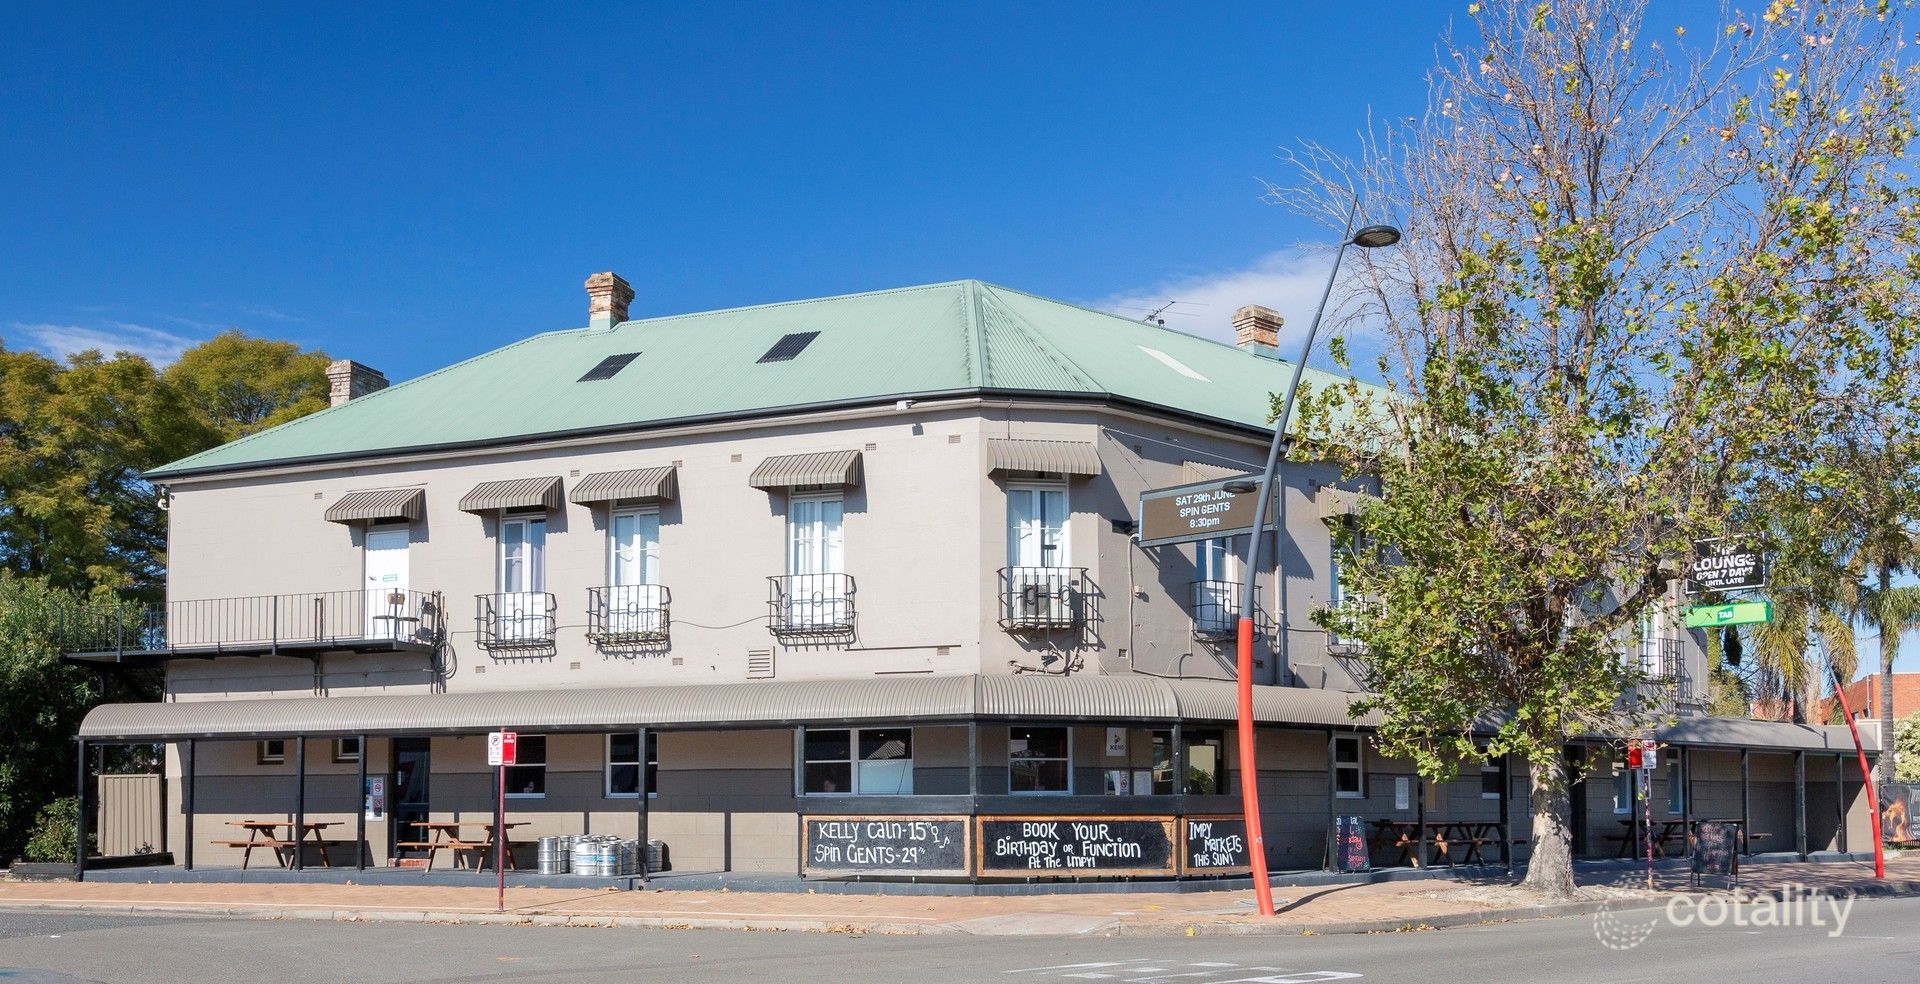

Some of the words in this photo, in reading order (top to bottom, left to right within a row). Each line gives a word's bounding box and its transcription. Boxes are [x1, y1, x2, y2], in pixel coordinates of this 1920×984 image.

[1175, 495, 1192, 506] SAT
[1193, 493, 1210, 504] 29th
[1180, 507, 1200, 518] SPIN
[1201, 502, 1231, 514] GENTS
[1190, 517, 1220, 528] 8:30pm
[1693, 554, 1756, 572] LOUNGE
[1721, 569, 1728, 578] 7
[1705, 578, 1725, 586] UNTIL
[1718, 611, 1733, 619] TAB
[819, 822, 860, 843] KELLY
[1023, 822, 1060, 840] BOOK
[1072, 822, 1114, 842] YOUR
[1189, 822, 1212, 840] IMPY
[1212, 852, 1235, 866] SUN!
